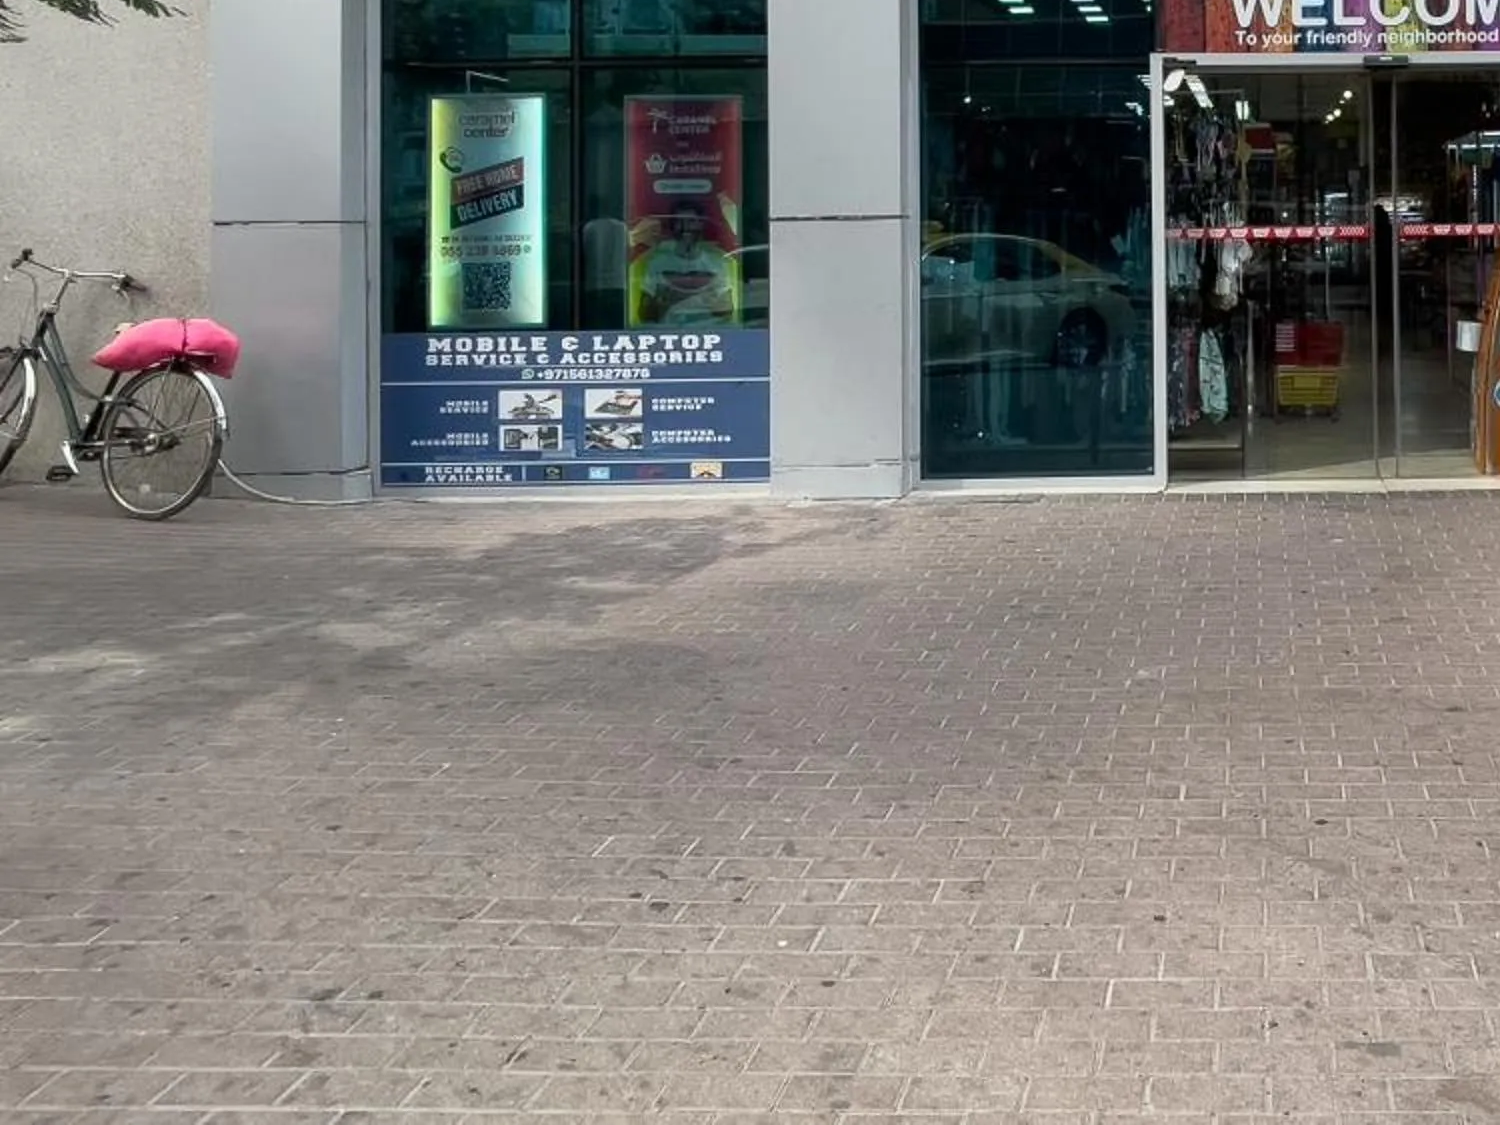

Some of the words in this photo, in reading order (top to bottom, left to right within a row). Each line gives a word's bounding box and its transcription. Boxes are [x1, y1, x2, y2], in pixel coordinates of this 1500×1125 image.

[1236, 31, 1256, 45] To
[1261, 32, 1302, 49] your
[1306, 29, 1373, 48] friendly
[1377, 29, 1499, 48] neighborhood
[457, 188, 518, 222] DELIVERY
[427, 337, 547, 353] MOBILE
[592, 334, 722, 351] LAPTOP
[426, 353, 528, 366] SERVICE
[560, 351, 724, 365] ACCESSORIES
